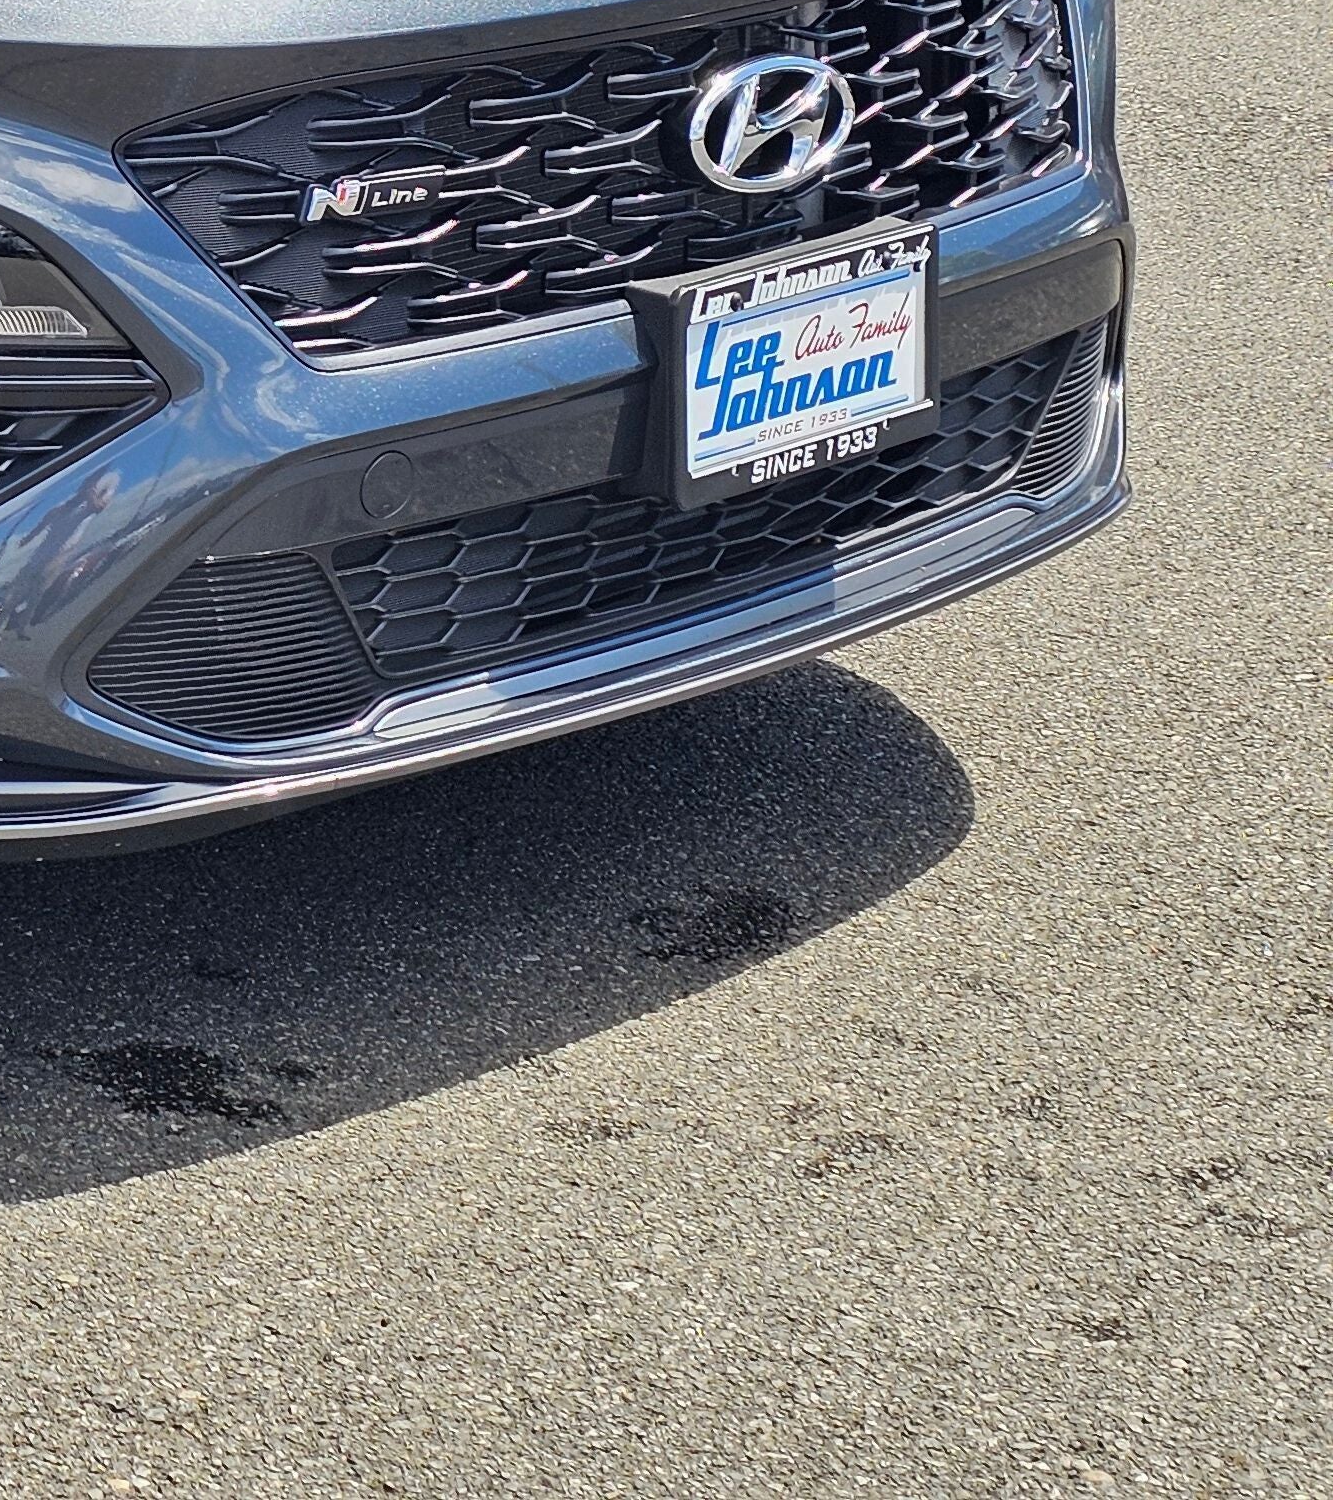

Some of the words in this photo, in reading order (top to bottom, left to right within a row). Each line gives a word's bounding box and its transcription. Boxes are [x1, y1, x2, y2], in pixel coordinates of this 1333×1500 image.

[371, 186, 429, 208] Line
[744, 259, 853, 309] Johnson
[694, 321, 786, 390] Lee
[795, 314, 845, 360] Auto
[848, 291, 912, 350] Family
[698, 349, 898, 442] Johnson
[757, 417, 804, 443] SINCE
[810, 407, 849, 429] 1933
[751, 443, 817, 484] SINCE
[825, 425, 879, 461] 1933
